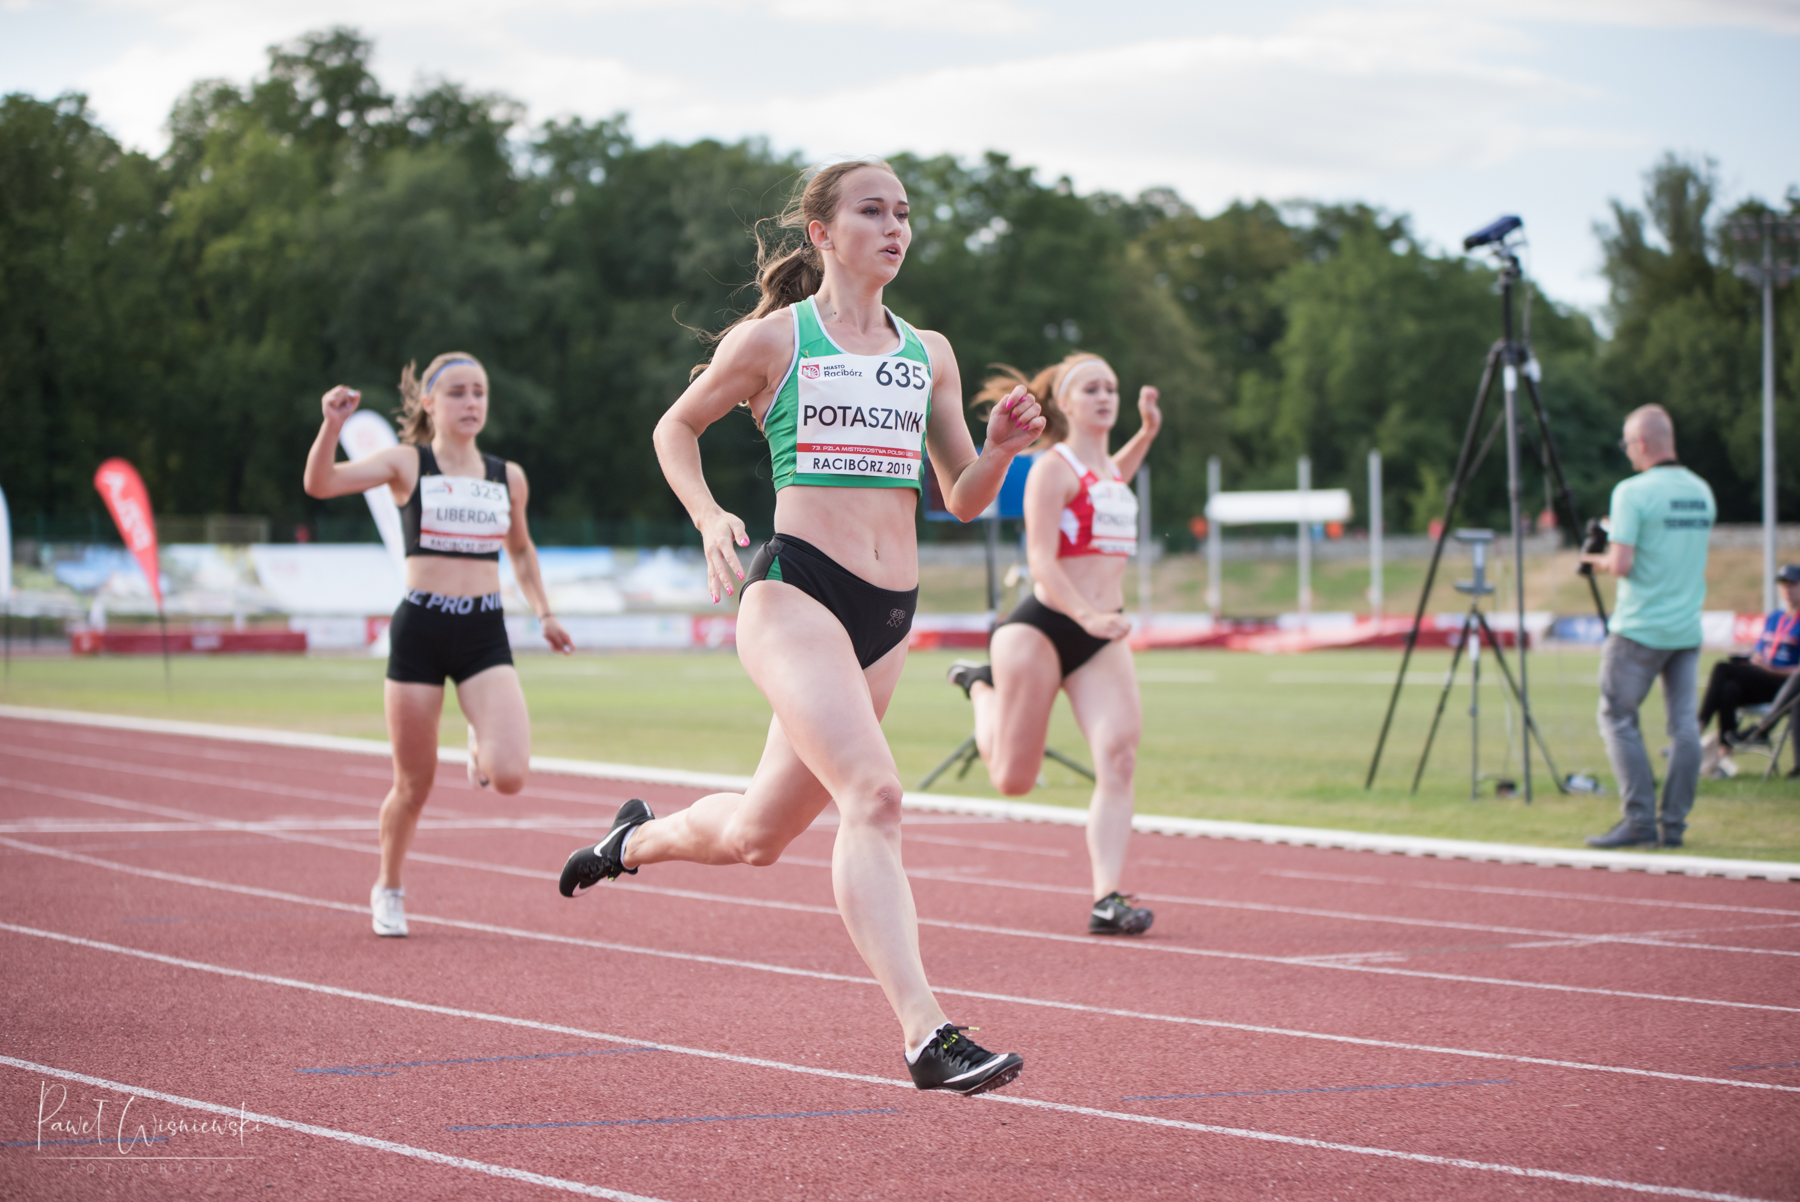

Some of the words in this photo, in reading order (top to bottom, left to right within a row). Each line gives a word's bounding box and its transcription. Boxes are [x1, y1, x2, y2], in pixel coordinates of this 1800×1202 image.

[823, 369, 863, 378] Racibórz
[875, 361, 926, 390] 635
[803, 404, 924, 433] POTASZNIK
[841, 446, 887, 455] MISTRZOSTWA
[812, 456, 884, 473] RACIBÓRZ
[886, 461, 912, 475] 2019
[470, 482, 502, 501] 325
[436, 507, 498, 524] LIBERDA
[426, 593, 474, 615] PRO
